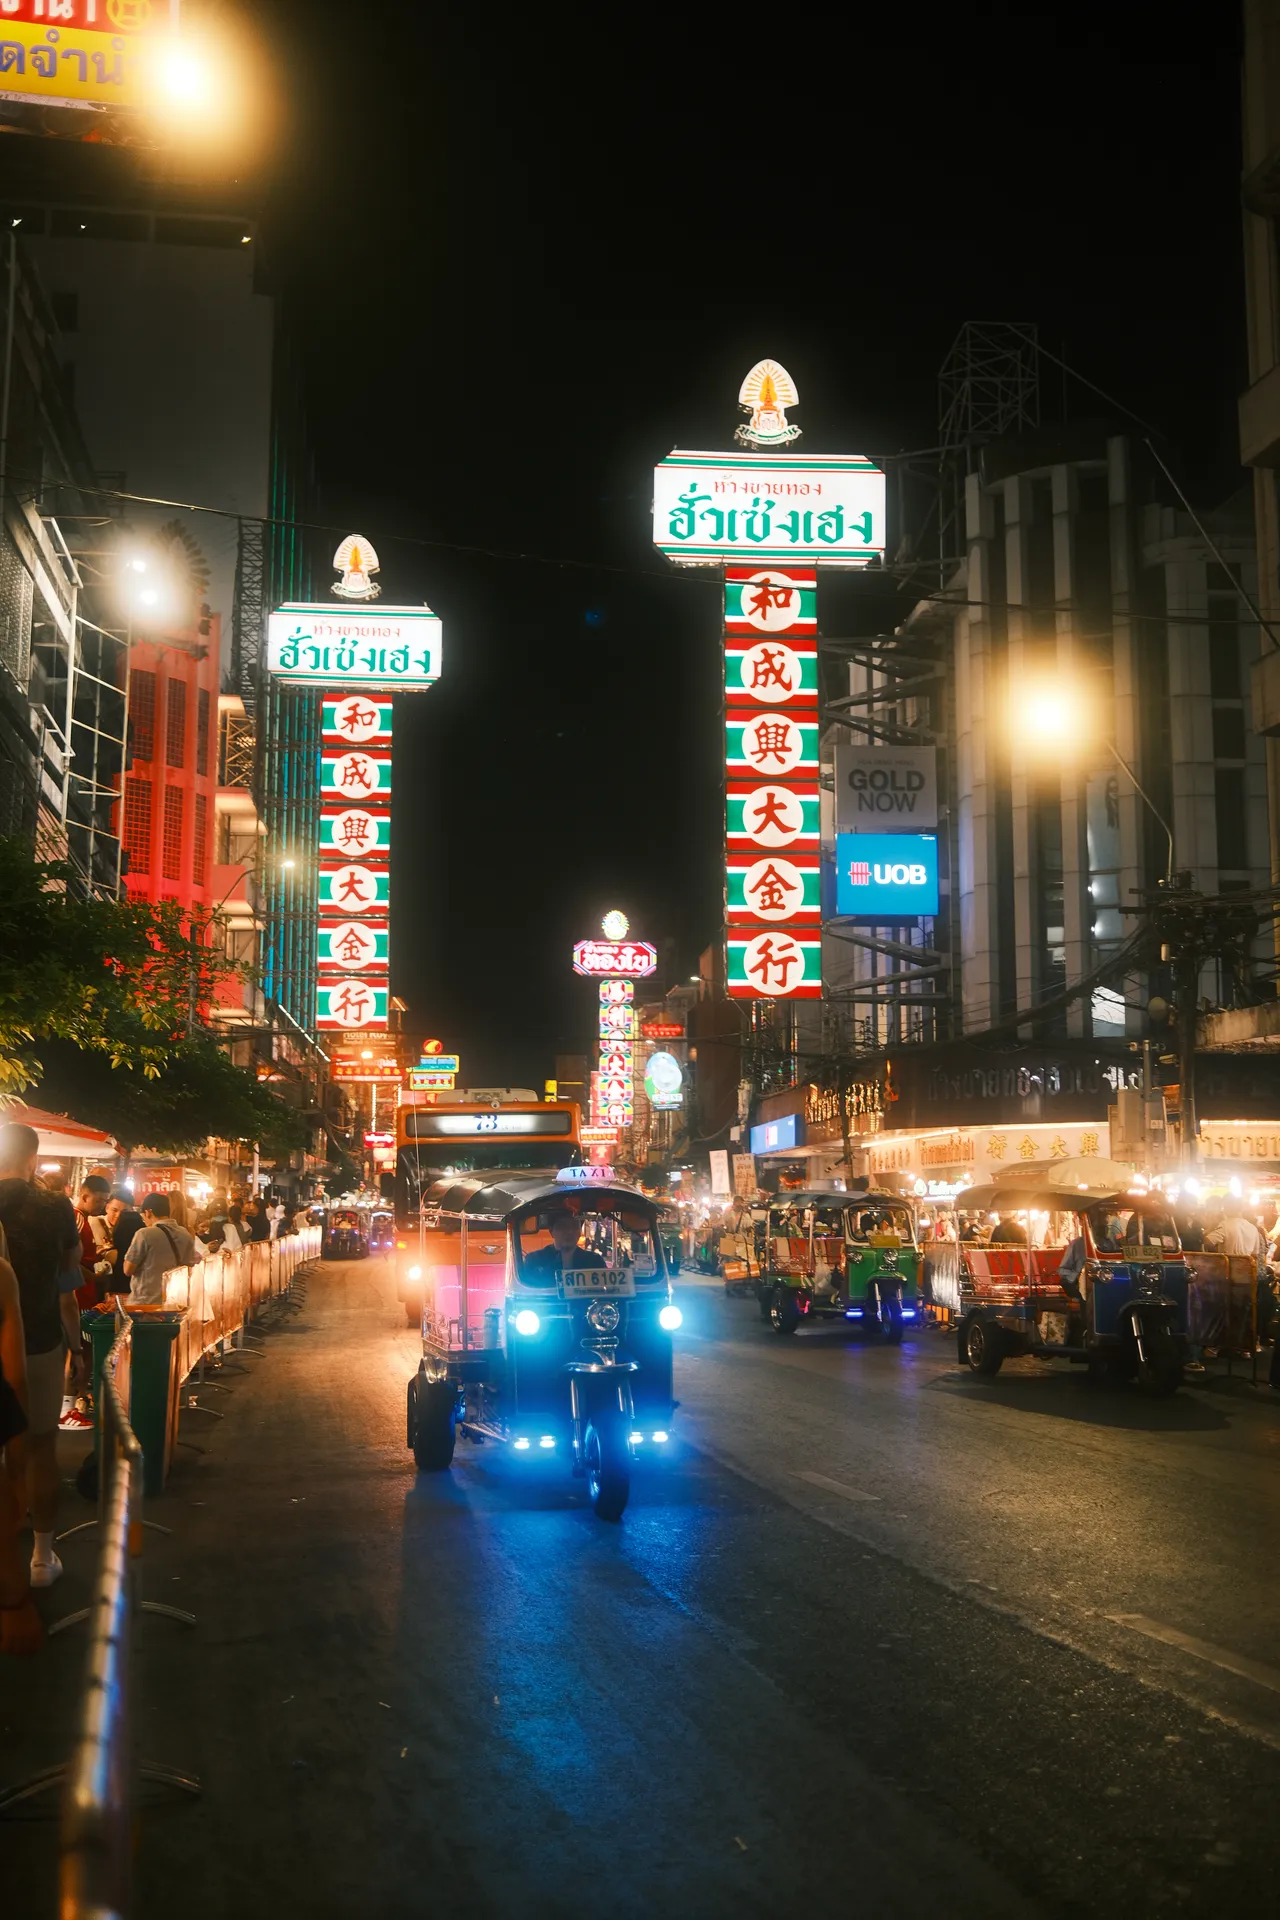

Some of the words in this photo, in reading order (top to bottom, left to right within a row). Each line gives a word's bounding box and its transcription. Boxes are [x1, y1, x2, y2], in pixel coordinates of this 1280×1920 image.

[713, 474, 822, 496] ห้างขายทอง
[668, 482, 873, 544] ฮั่วเซ่งเฮง
[279, 626, 431, 674] ฮั่วเซ่งเฮง
[848, 769, 925, 791] GOLD
[858, 792, 917, 812] NOW
[874, 864, 927, 884] UOB
[473, 1114, 498, 1131] 73
[569, 1168, 606, 1178] TAXI
[591, 1271, 627, 1285] 6102
